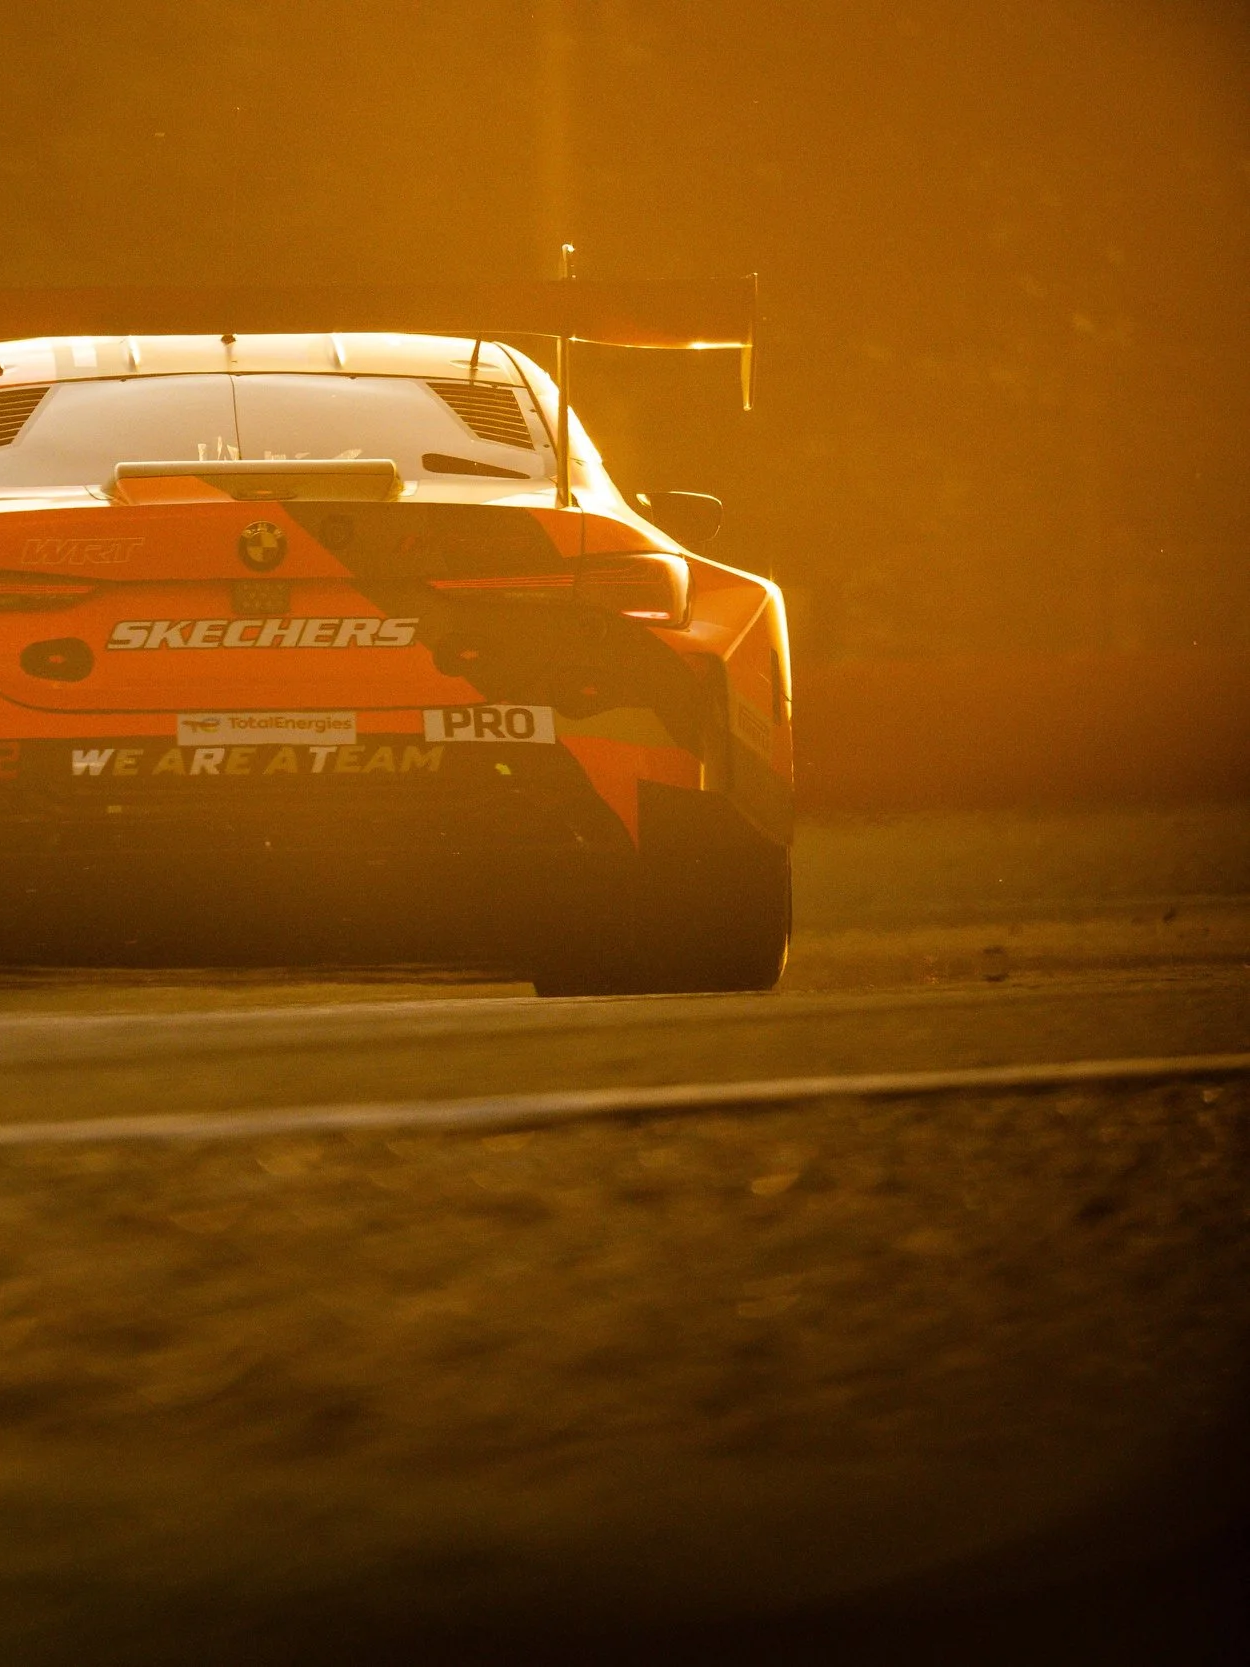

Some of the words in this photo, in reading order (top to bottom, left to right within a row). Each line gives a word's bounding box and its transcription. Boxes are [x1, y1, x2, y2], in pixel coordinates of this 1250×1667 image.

[21, 537, 146, 566] WRT
[107, 618, 420, 650] SKECHERS
[227, 716, 353, 733] TotalEnergies
[443, 707, 536, 740] PRO
[71, 748, 144, 776] WE
[151, 747, 257, 776] ARE
